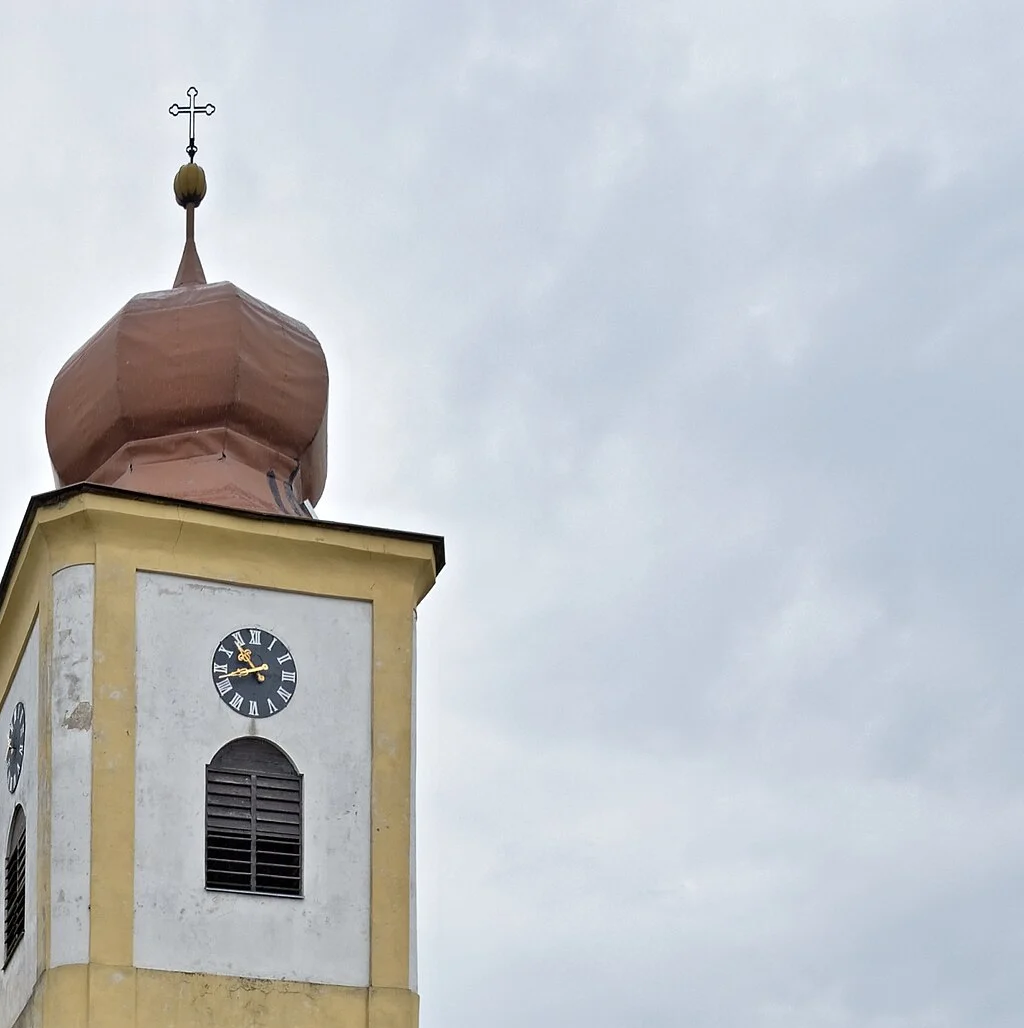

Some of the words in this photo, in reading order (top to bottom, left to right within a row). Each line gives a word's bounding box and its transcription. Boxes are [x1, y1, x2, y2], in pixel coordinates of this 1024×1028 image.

[249, 630, 261, 645] XII
[268, 638, 277, 651] I
[218, 645, 233, 658] X
[277, 653, 291, 664] II
[214, 662, 227, 673] IX
[282, 671, 295, 683] III
[277, 686, 291, 702] IV
[249, 701, 259, 715] VI
[267, 698, 278, 714] V
